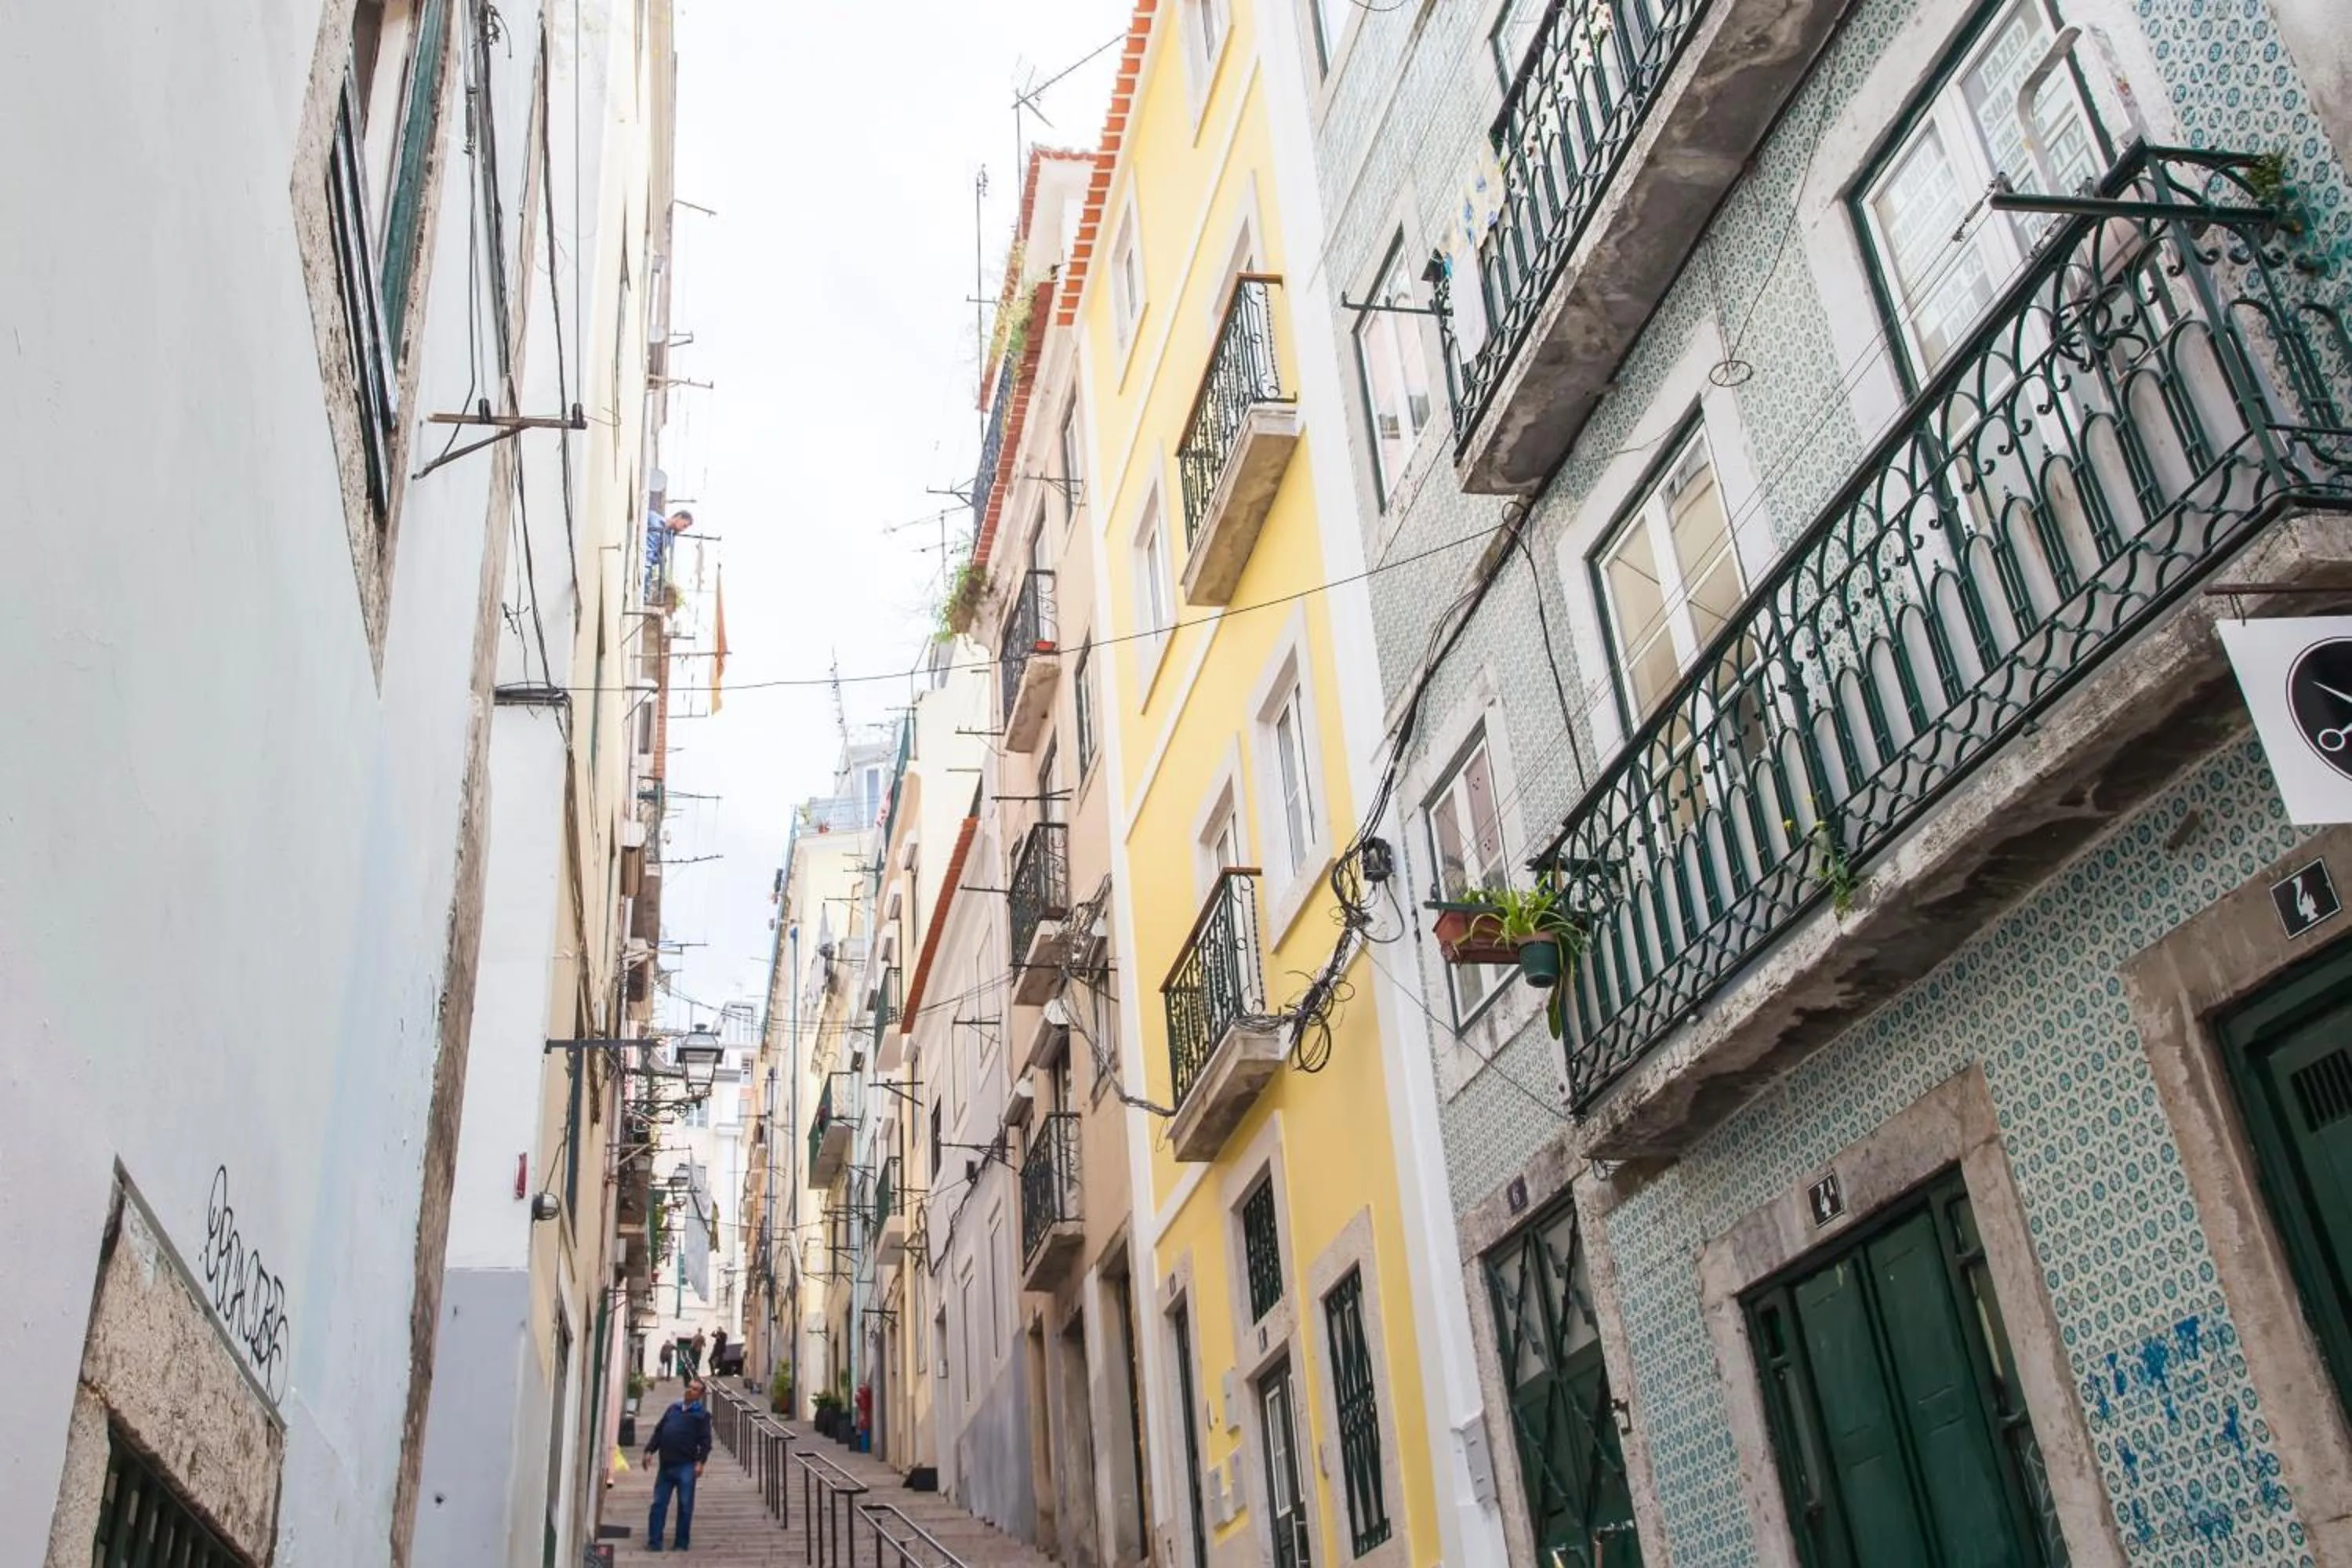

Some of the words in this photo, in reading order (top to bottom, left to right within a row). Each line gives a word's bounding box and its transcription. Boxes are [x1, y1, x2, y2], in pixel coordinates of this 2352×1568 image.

[1983, 21, 2027, 88] FAZER
[1980, 82, 2013, 134] SUA
[2010, 32, 2050, 93] CASA
[2292, 877, 2318, 922] 4
[1512, 1184, 1520, 1205] 6
